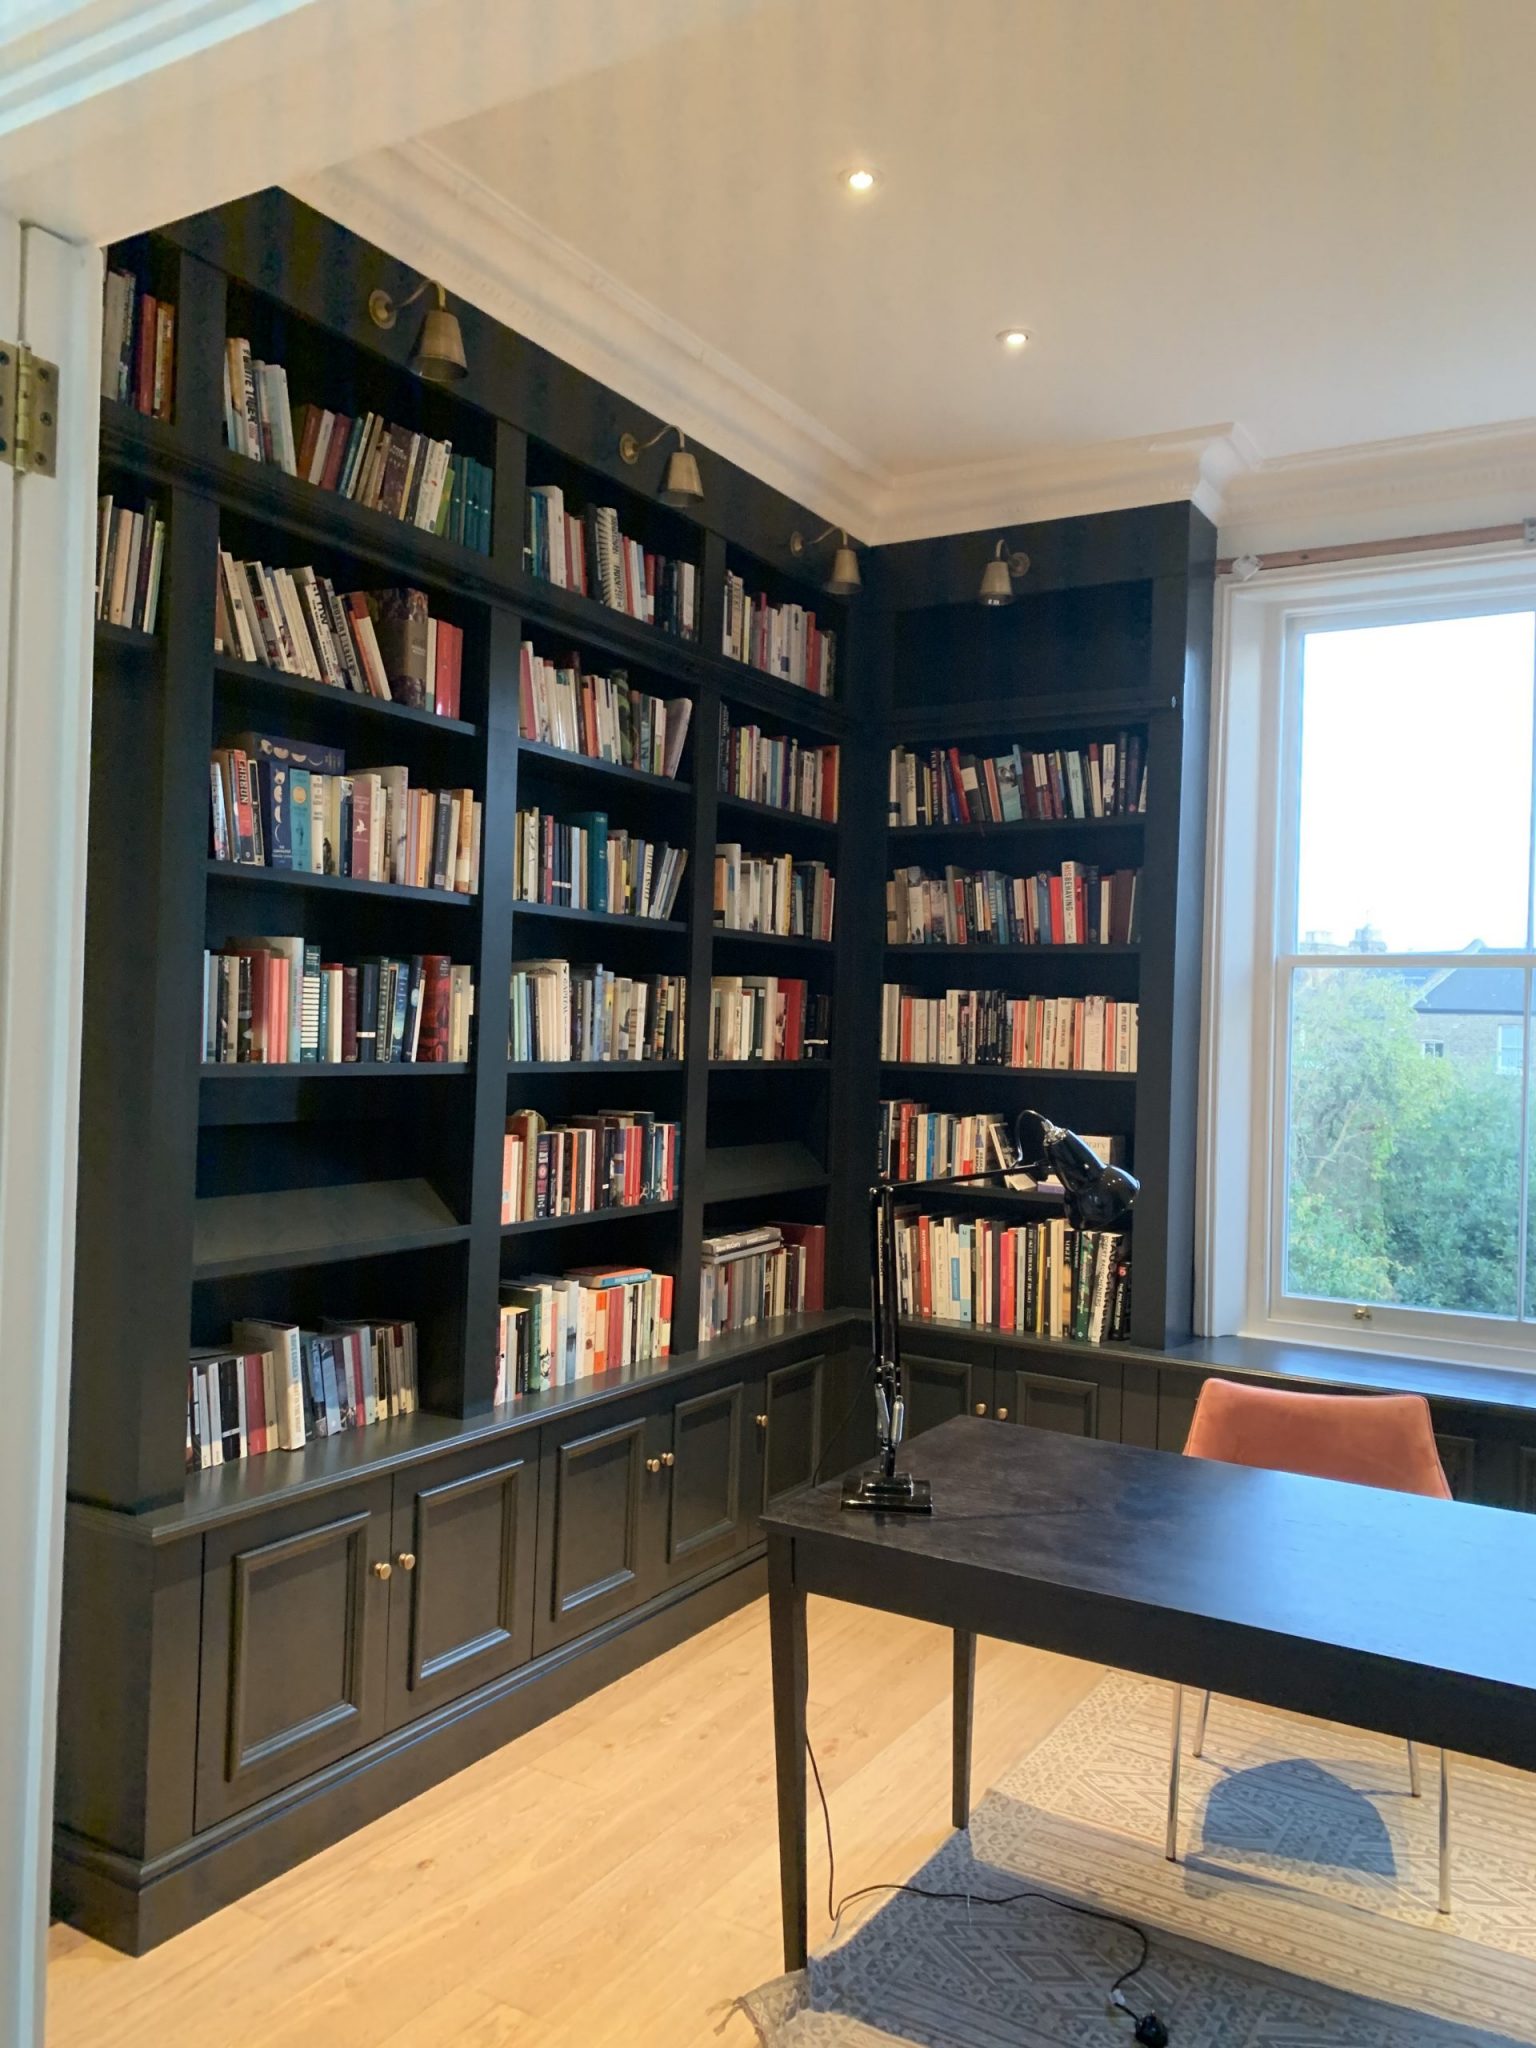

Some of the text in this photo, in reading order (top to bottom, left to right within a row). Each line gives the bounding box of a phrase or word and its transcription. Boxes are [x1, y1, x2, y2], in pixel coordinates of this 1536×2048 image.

[239, 760, 249, 806] CHABON
[644, 871, 652, 900] CASTLE
[1064, 864, 1074, 912] MISBEHAVING
[1095, 1235, 1109, 1308] ROBERT RAUSCHENBERG
